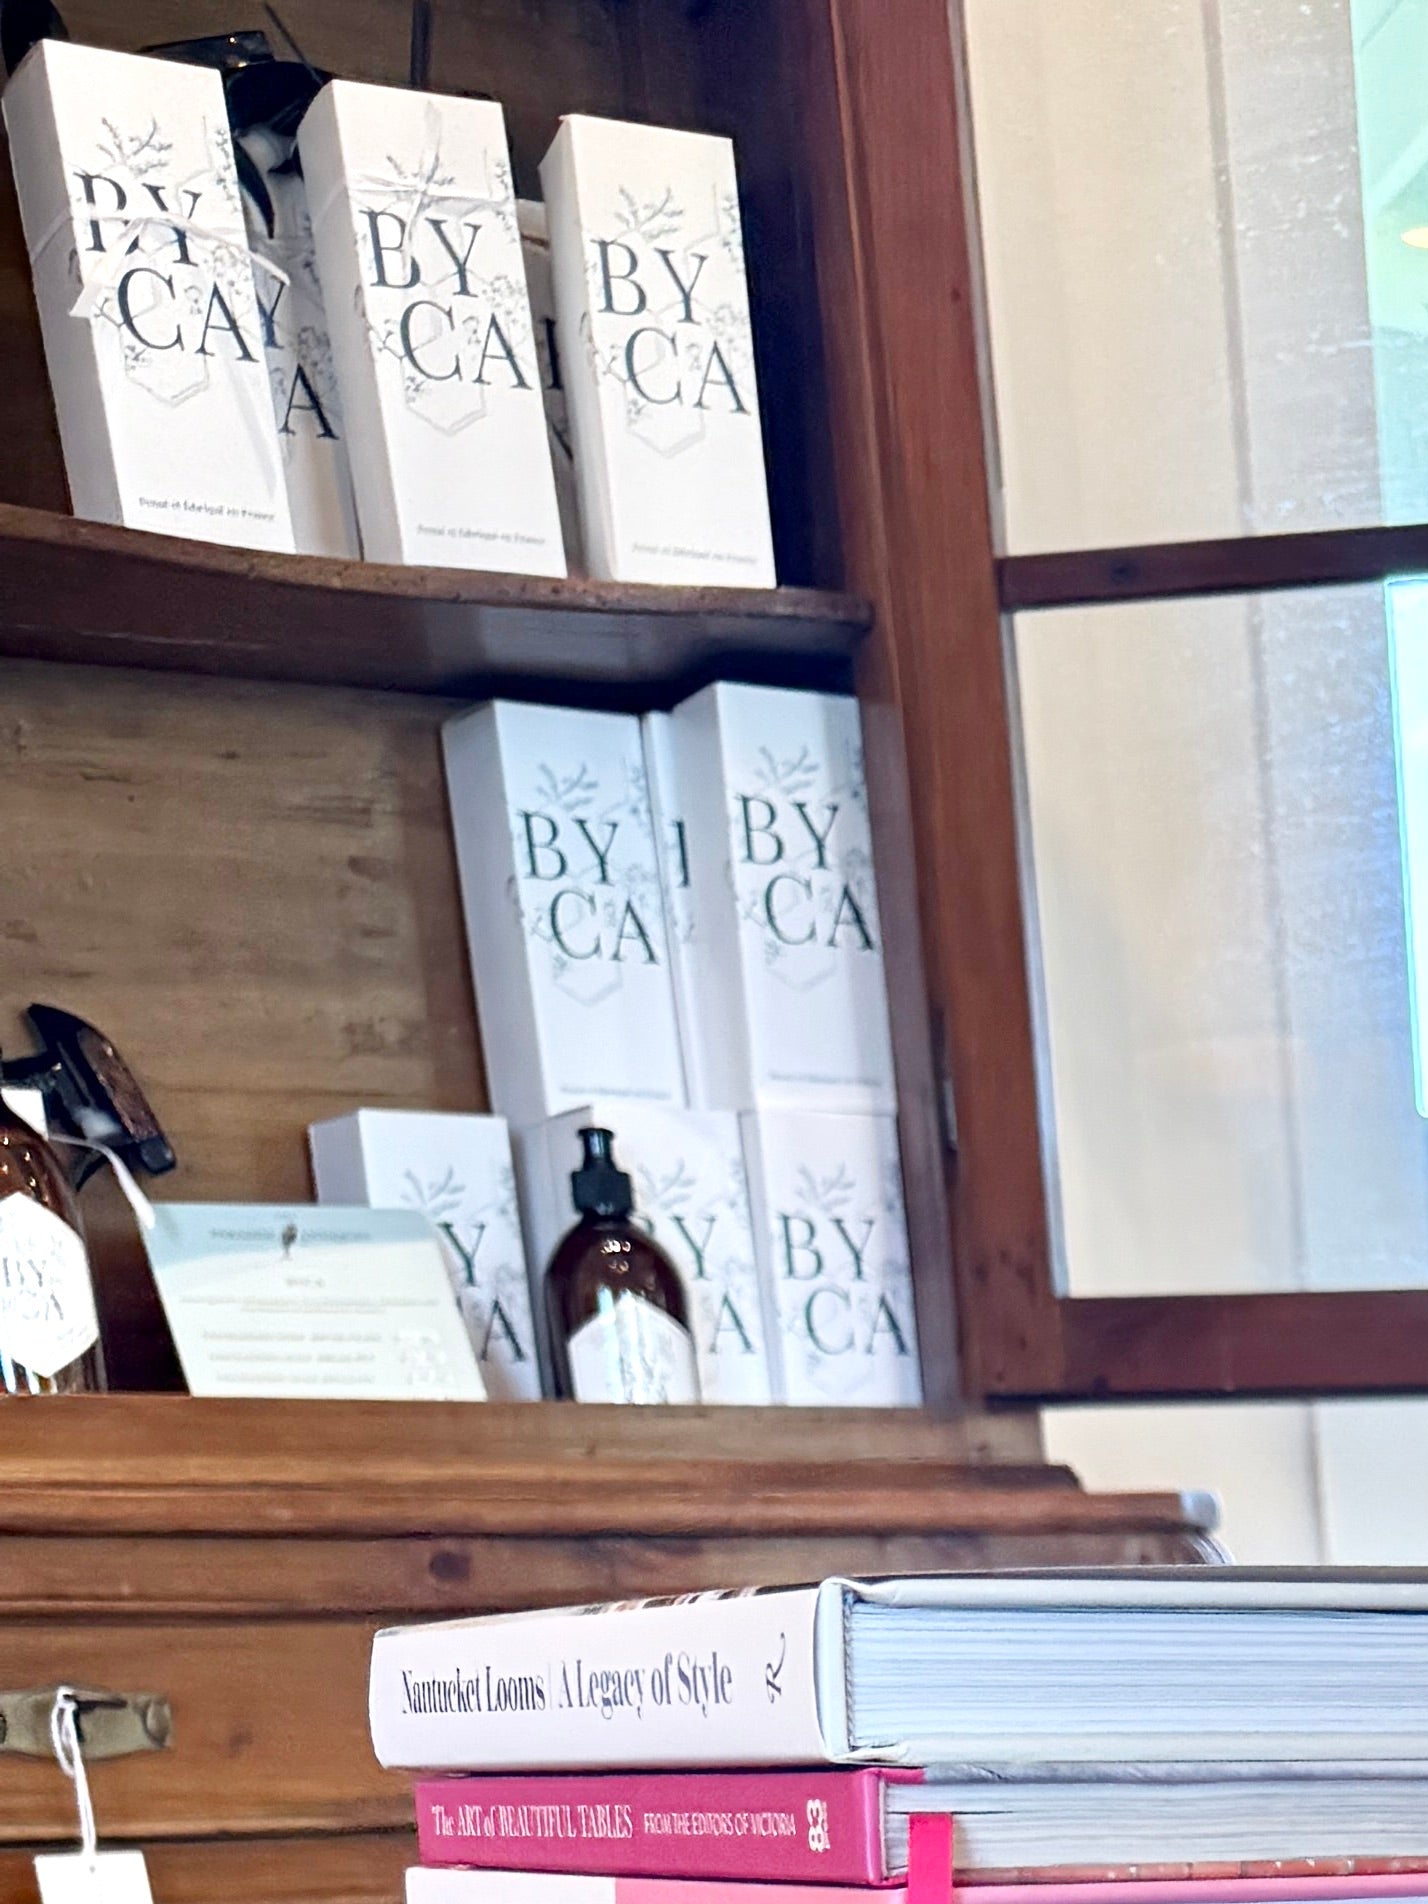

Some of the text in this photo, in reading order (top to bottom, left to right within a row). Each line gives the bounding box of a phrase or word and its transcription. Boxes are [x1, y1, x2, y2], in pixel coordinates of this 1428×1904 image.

[359, 210, 482, 298] BY
[590, 239, 708, 324] BY
[118, 268, 259, 362] CA
[400, 300, 534, 390] CA
[278, 363, 340, 440] A
[625, 327, 751, 416] CA
[516, 809, 618, 887] BY
[735, 793, 839, 870] BY
[550, 889, 660, 965] CA
[765, 874, 874, 951] CA
[777, 1213, 874, 1281] BY
[709, 1294, 757, 1355] A
[805, 1284, 909, 1356] CA
[400, 1651, 732, 1720] Nantucket Looms A Legacy of Style
[431, 1804, 633, 1839] The ART of BEAUTIFUL TABLES
